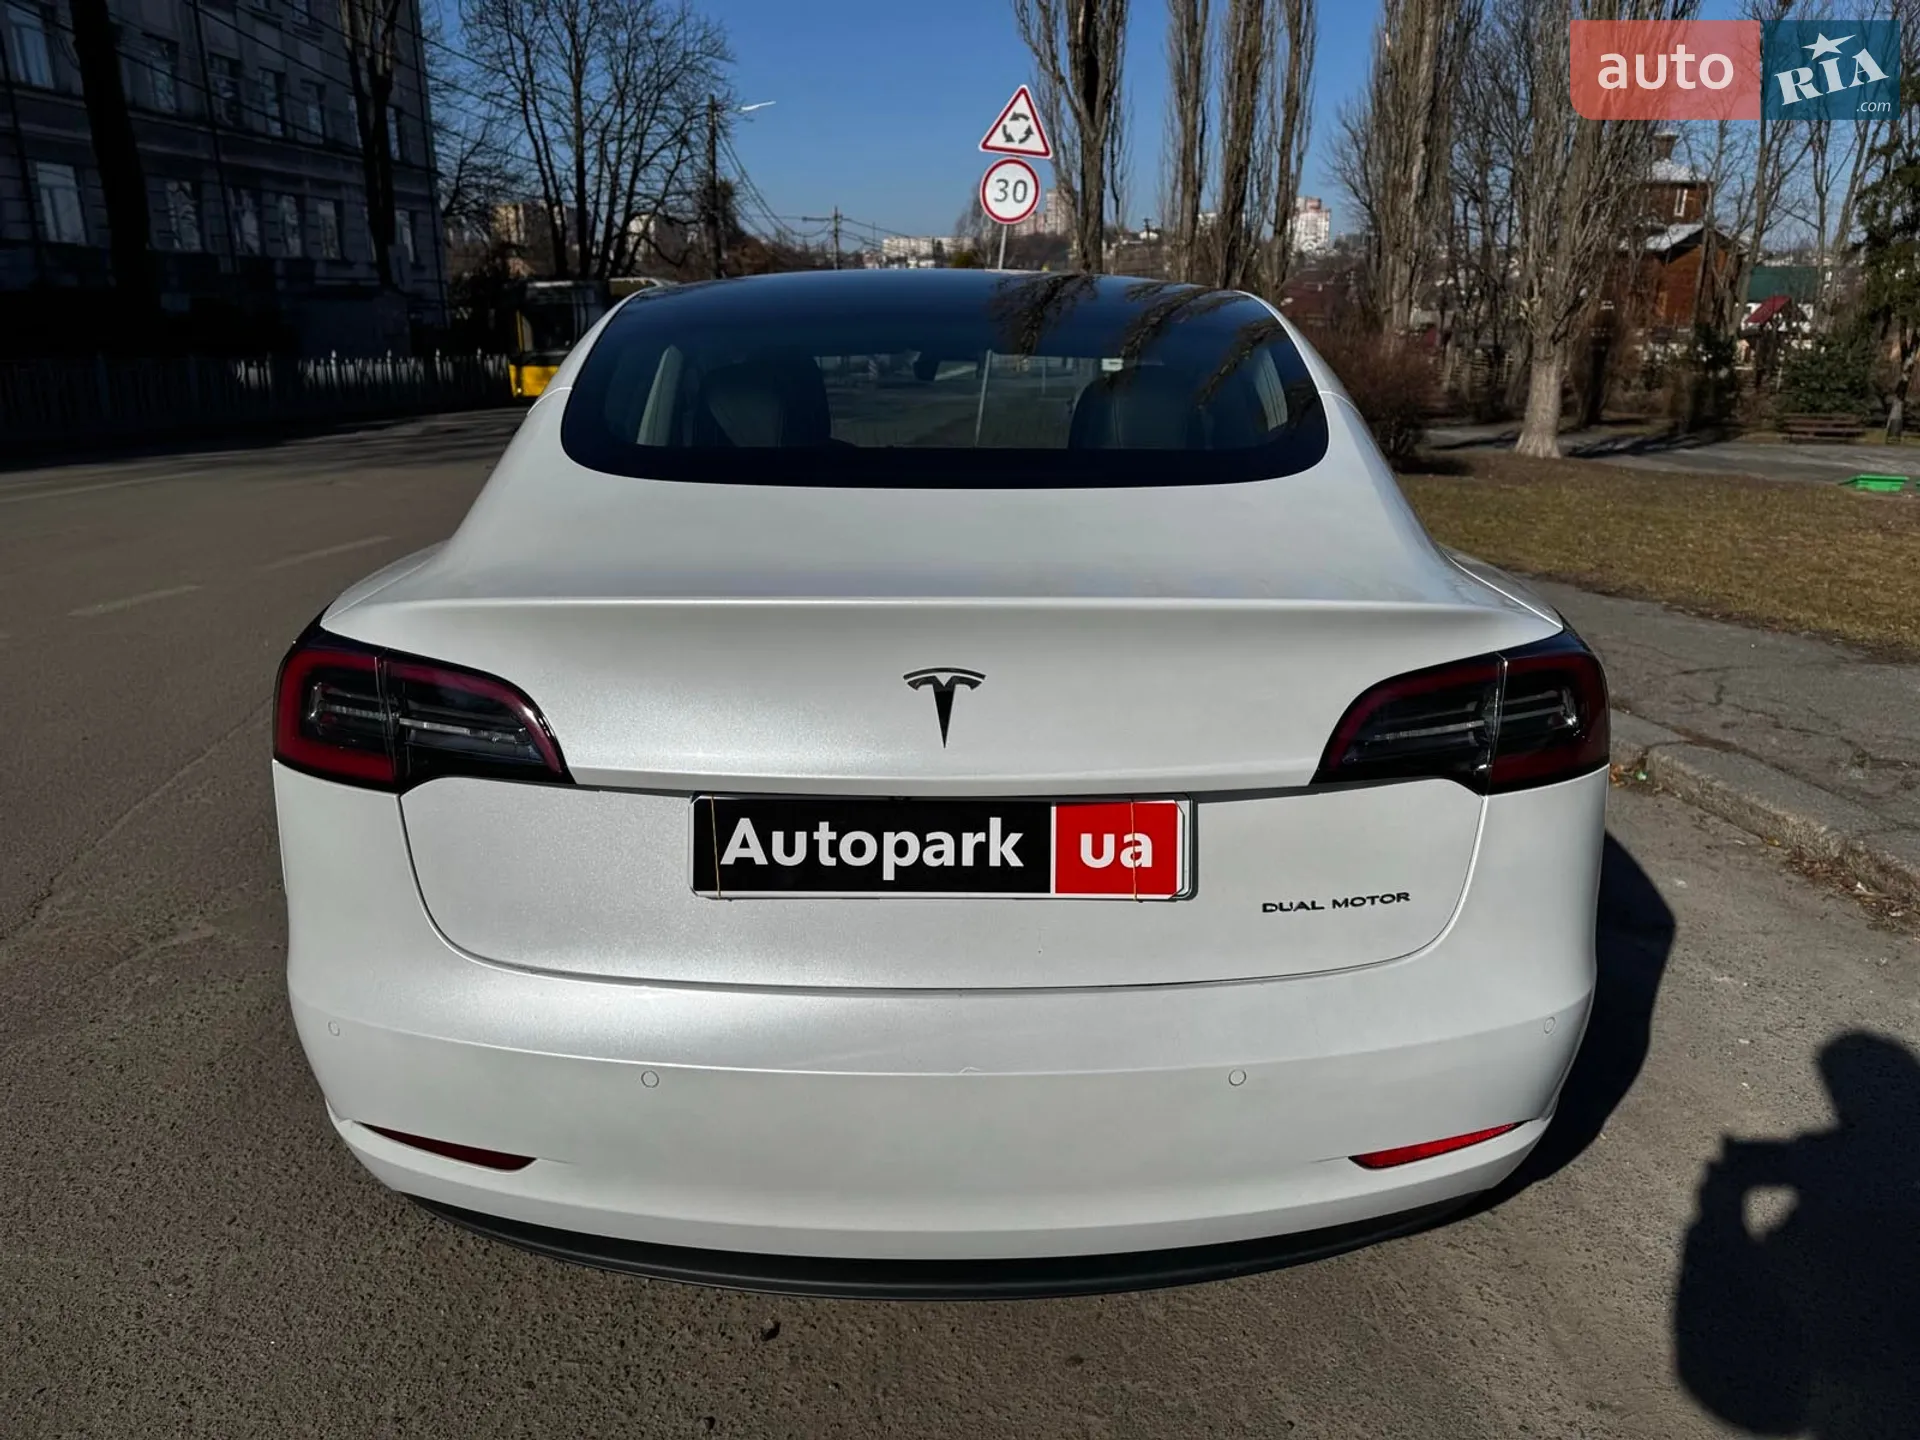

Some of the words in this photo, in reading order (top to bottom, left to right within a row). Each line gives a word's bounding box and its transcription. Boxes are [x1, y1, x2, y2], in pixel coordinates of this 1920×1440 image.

[994, 179, 1028, 204] 30
[720, 817, 1025, 881] Autopark
[1079, 832, 1154, 869] ua
[1261, 900, 1325, 913] DUAL
[1331, 892, 1411, 910] MOTOR
